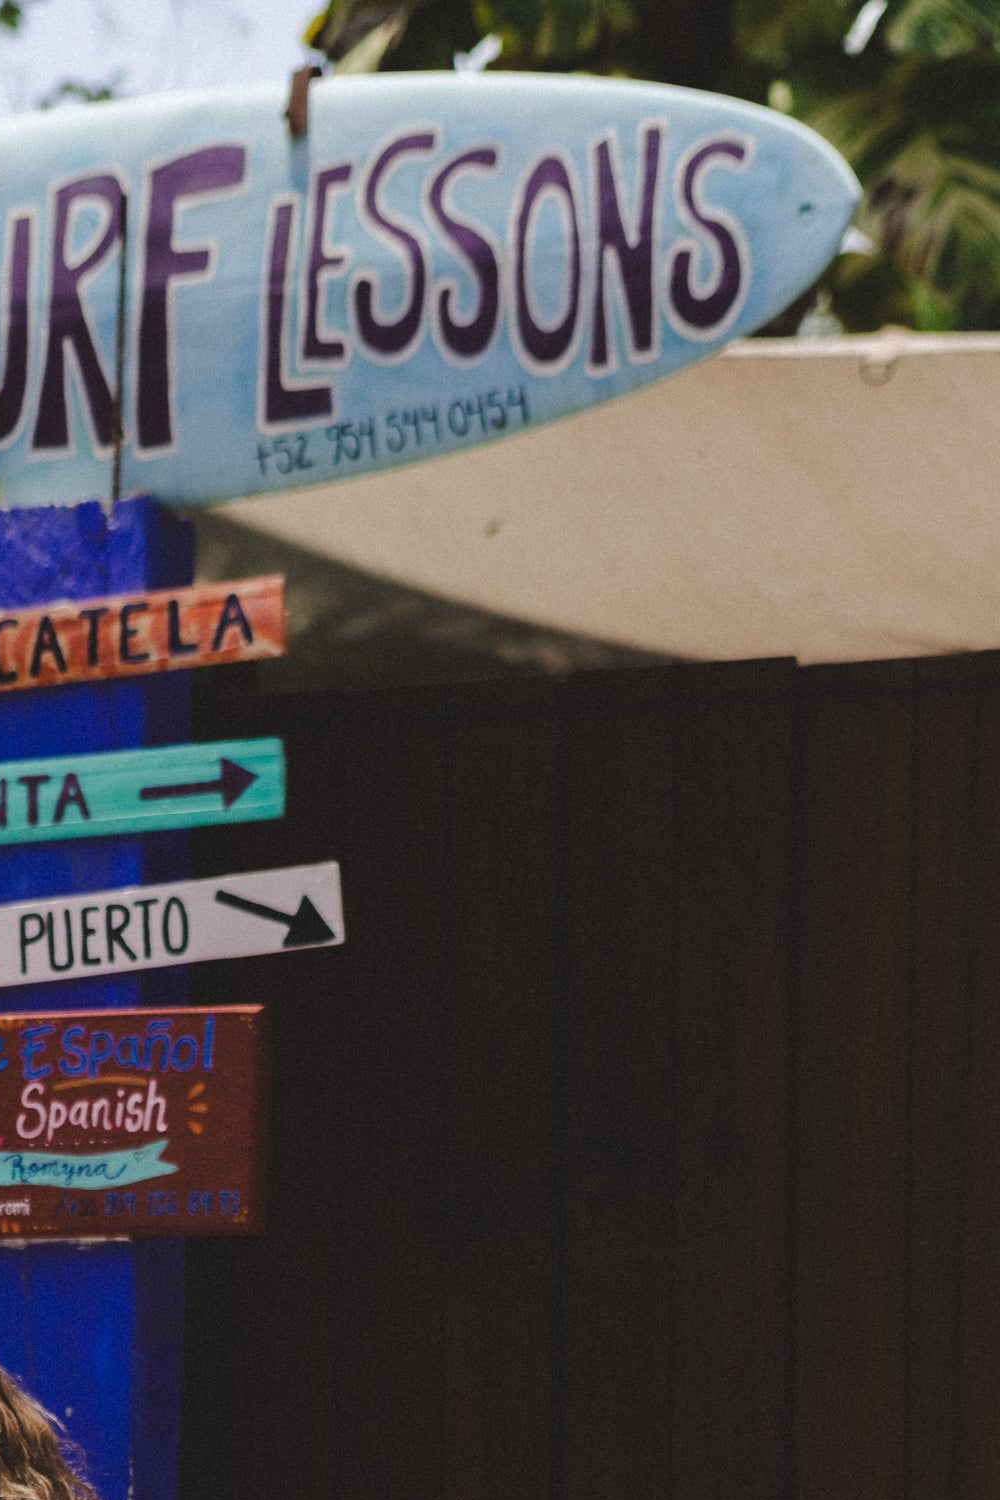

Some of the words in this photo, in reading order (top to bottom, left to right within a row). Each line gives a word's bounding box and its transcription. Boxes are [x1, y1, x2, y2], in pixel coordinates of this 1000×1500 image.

[260, 122, 752, 428] LESSONS
[256, 434, 314, 476] +52
[386, 404, 441, 453] 544
[449, 385, 531, 438] 0454
[18, 895, 191, 975] PUERTO
[19, 1014, 217, 1082] Español
[16, 1079, 169, 1144] Spanish
